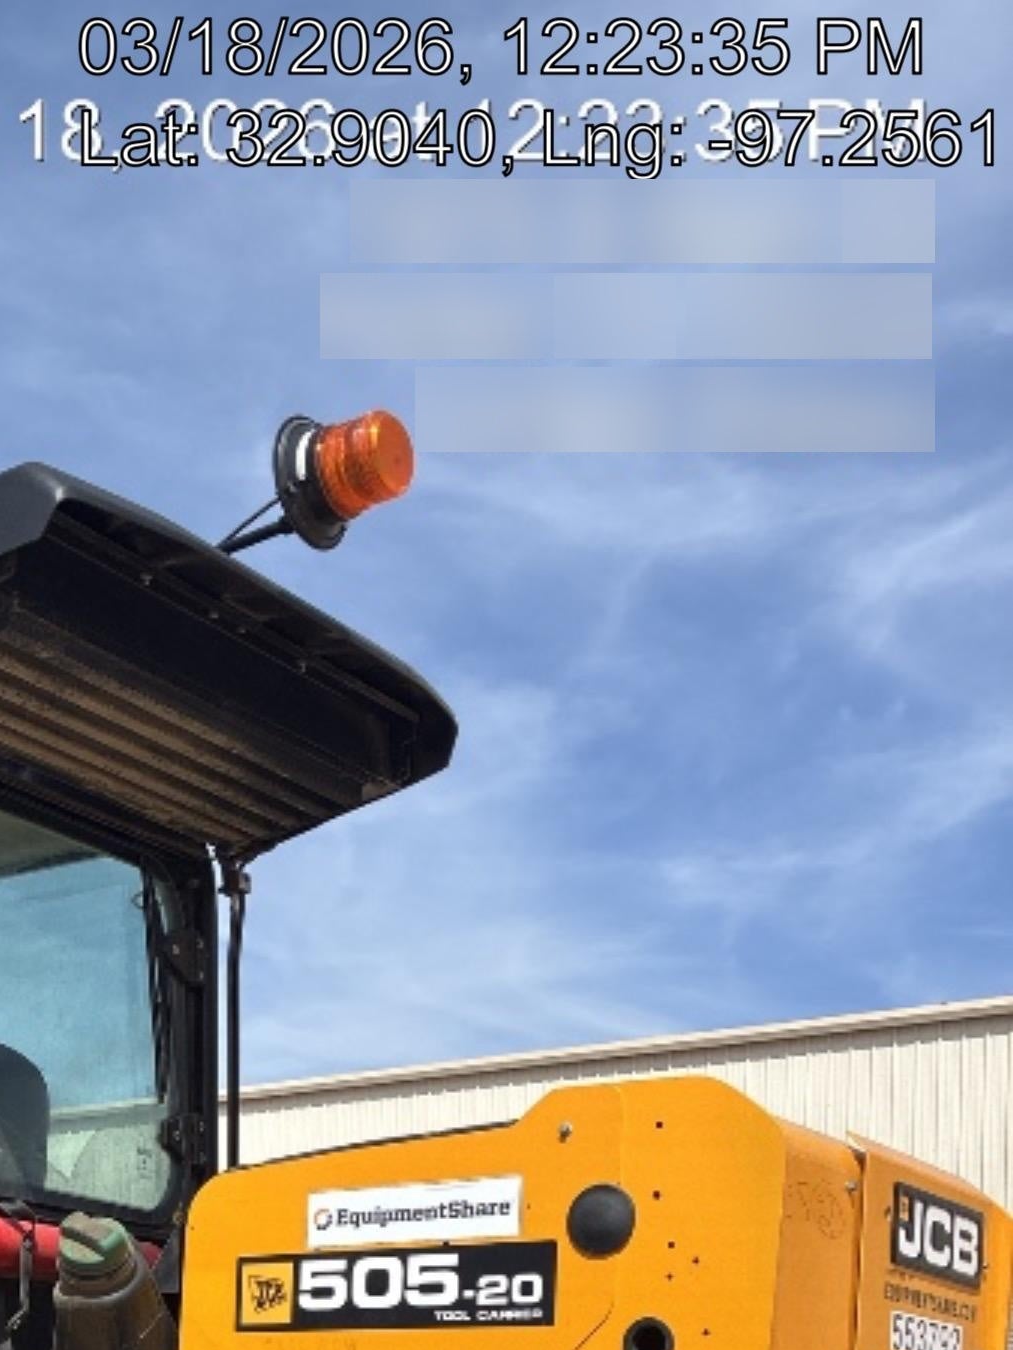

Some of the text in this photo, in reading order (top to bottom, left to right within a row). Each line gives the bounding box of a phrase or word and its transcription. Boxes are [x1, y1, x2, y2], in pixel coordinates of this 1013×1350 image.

[337, 1200, 511, 1228] EquipmentShare
[898, 1201, 979, 1277] JCB
[298, 1253, 544, 1311] 505-20
